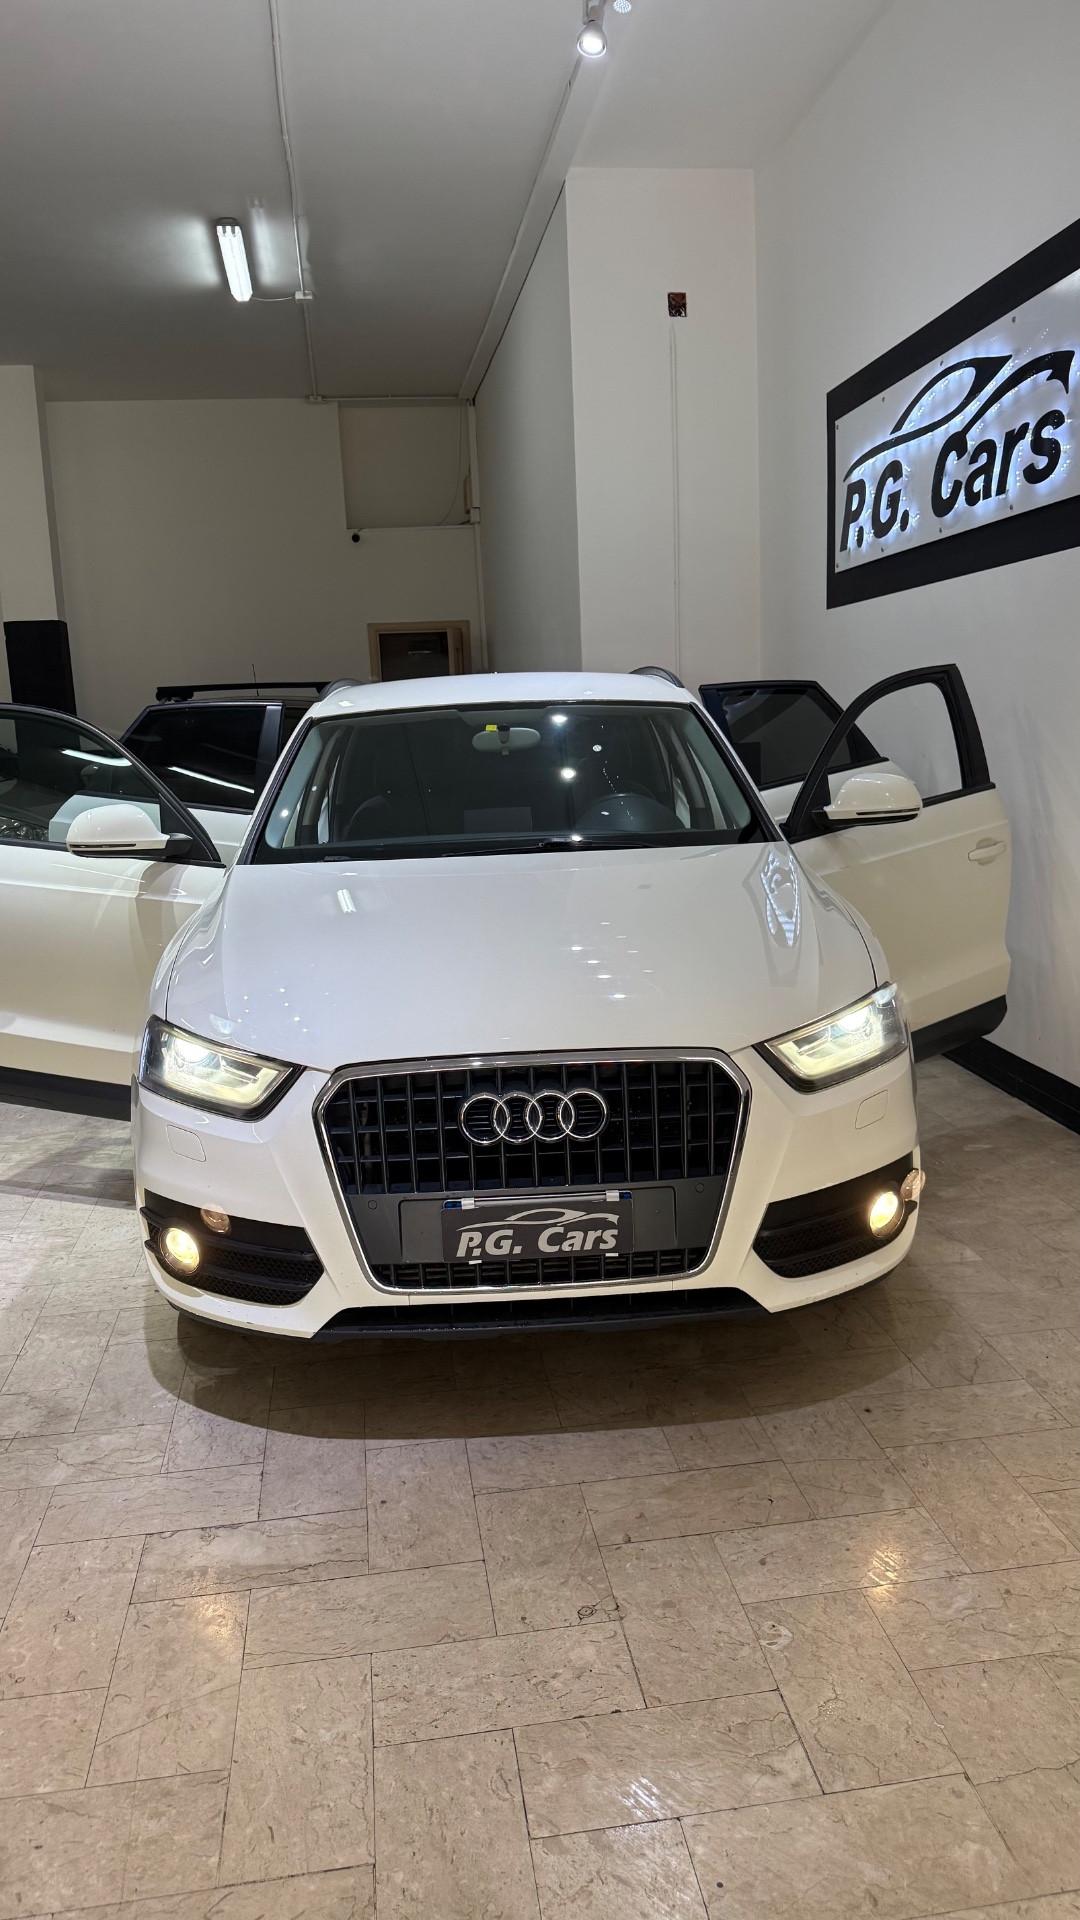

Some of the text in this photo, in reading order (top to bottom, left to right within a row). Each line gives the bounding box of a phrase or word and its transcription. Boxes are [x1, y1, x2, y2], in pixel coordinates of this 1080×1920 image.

[839, 409, 1067, 552] P.G. Cars
[455, 1226, 618, 1257] P.G. Cars
